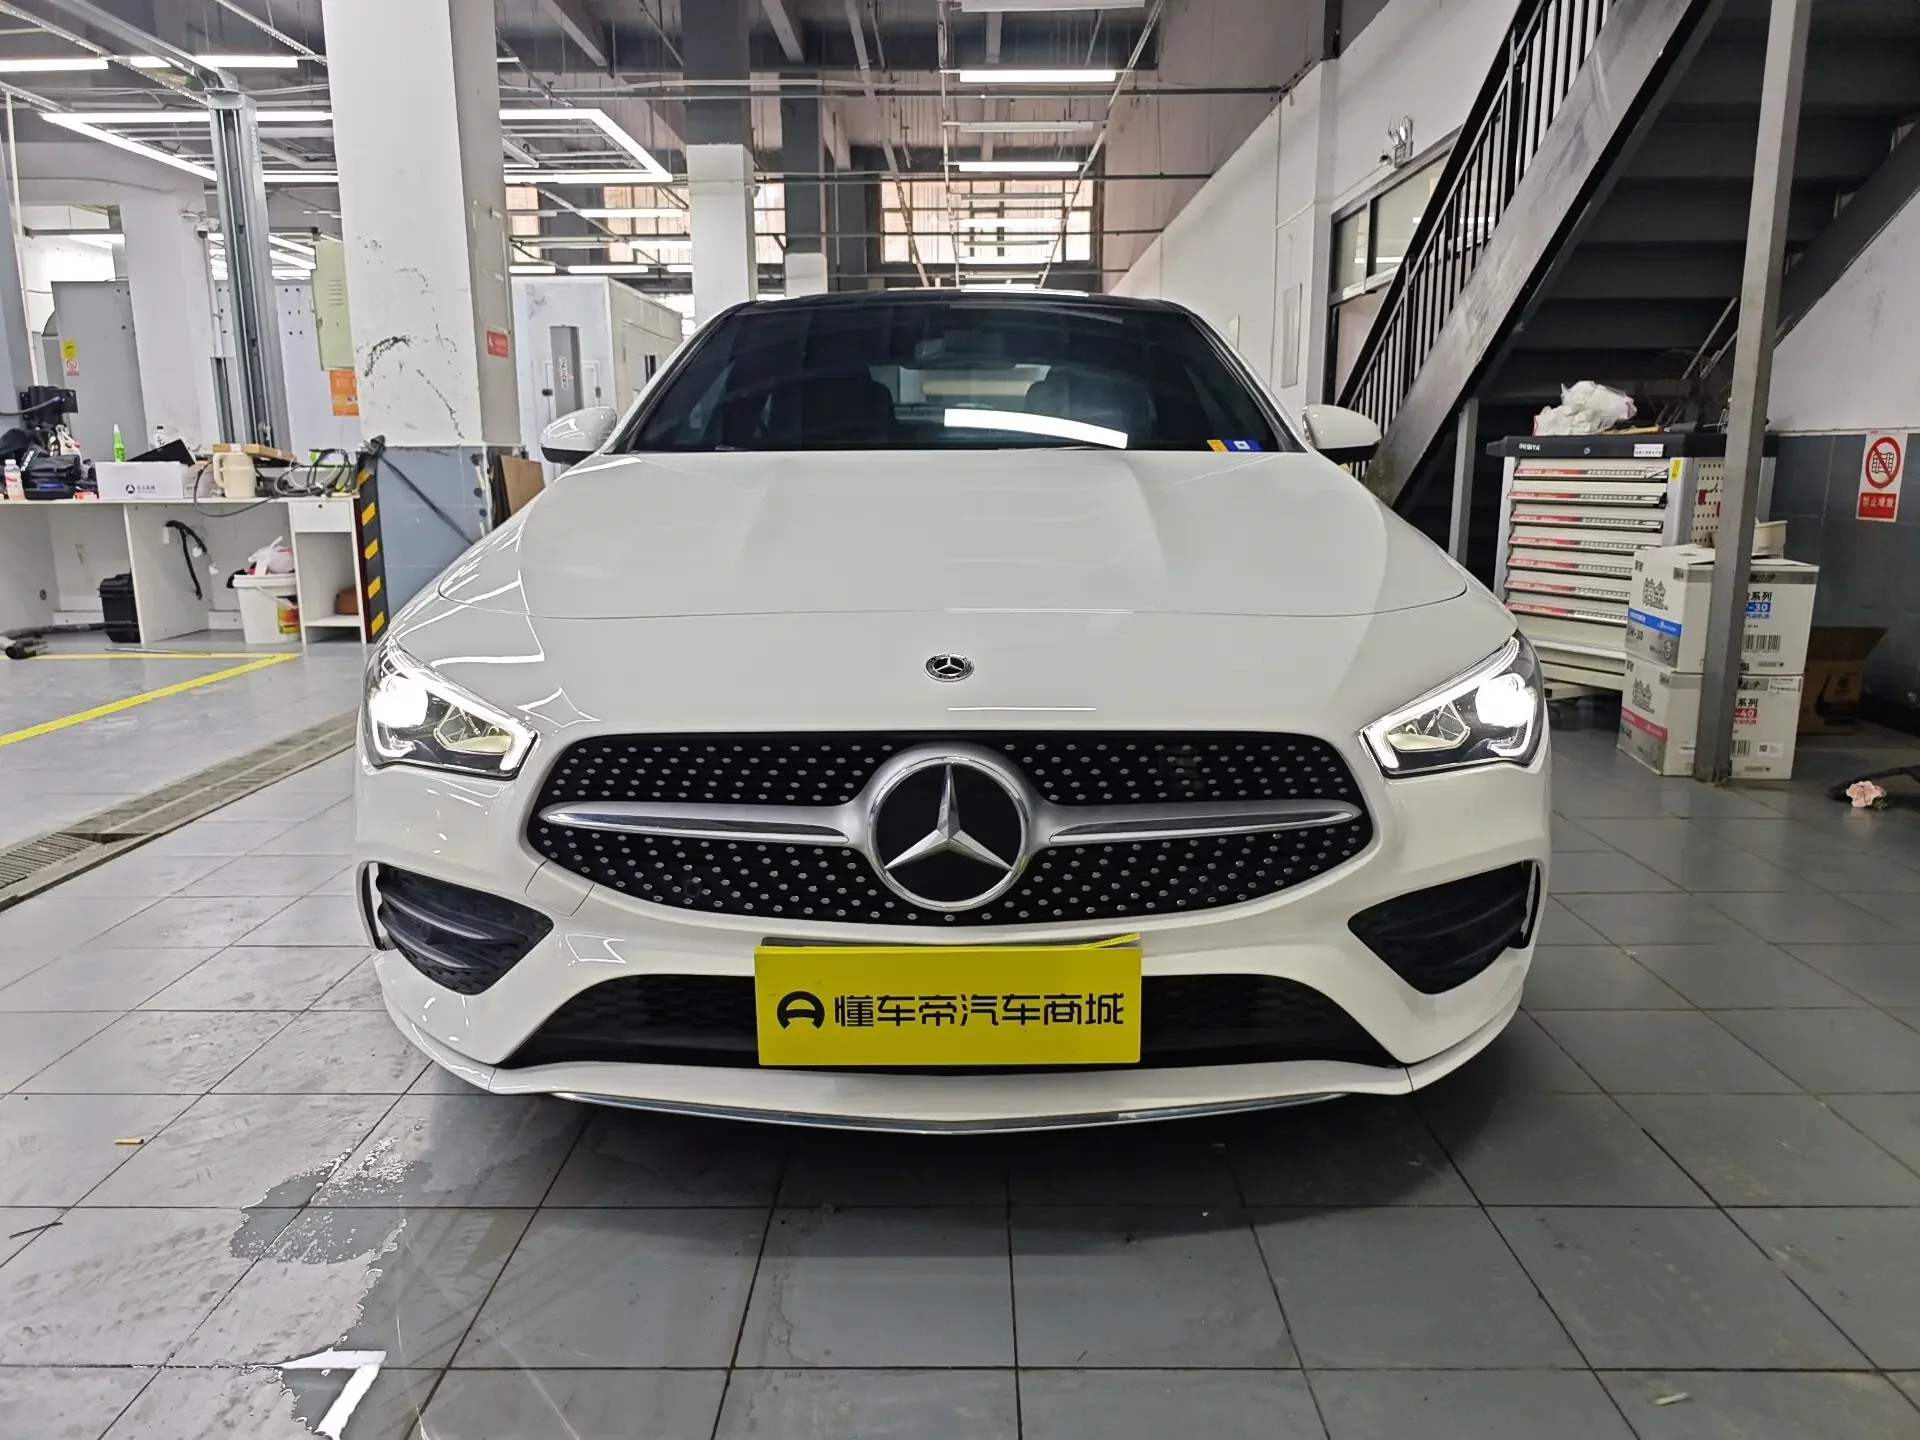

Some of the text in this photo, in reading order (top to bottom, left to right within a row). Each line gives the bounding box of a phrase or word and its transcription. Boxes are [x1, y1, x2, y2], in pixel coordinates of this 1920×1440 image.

[834, 992, 1124, 1027] 懂车帝汽车商城
